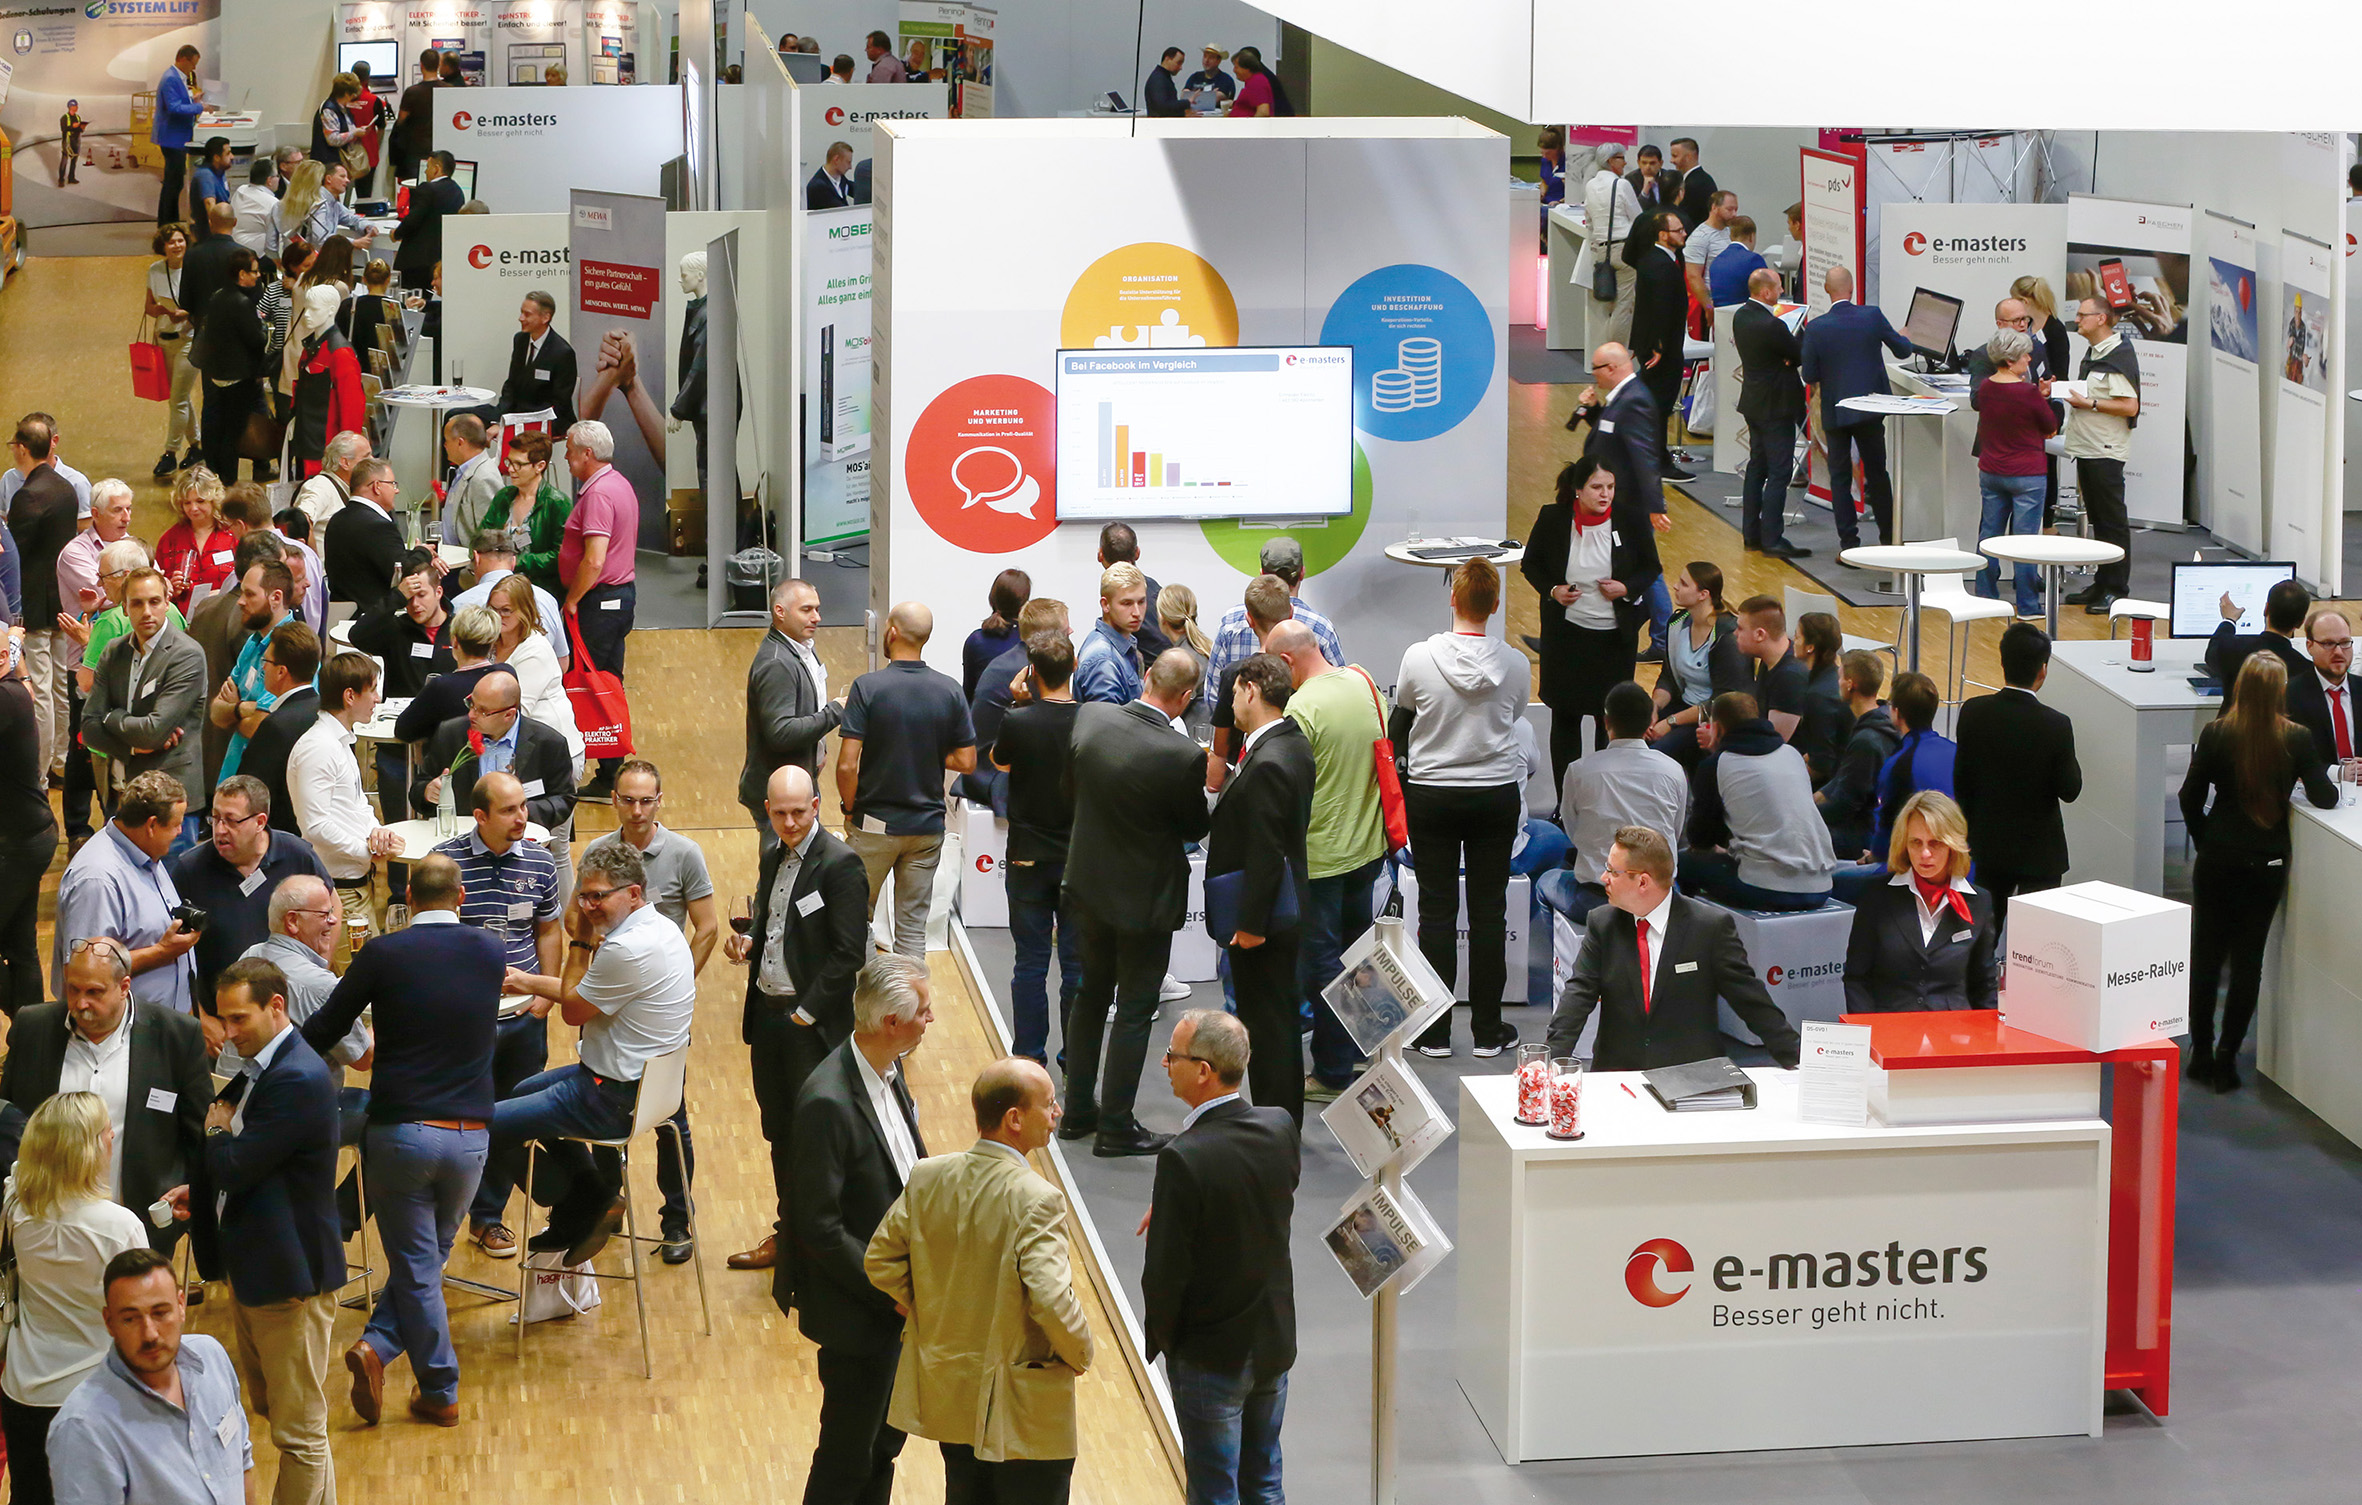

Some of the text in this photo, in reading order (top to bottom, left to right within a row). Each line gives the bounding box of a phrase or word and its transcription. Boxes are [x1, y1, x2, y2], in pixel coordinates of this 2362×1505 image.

[107, 1, 199, 14] SYSTEM LIFT
[497, 21, 525, 29] Einfach
[477, 113, 557, 127] e-masters
[849, 109, 929, 122] e-masters
[477, 129, 504, 137] Besser
[505, 129, 522, 138] geht
[849, 125, 873, 133] Besse
[1828, 178, 1841, 193] pds
[587, 210, 607, 221] MEWA
[1933, 235, 2027, 251] e-masters
[500, 246, 570, 264] e-mast
[1932, 254, 2012, 266] Besser geht nicht.
[500, 267, 532, 278] Besser
[535, 267, 557, 280] geht
[584, 265, 606, 276] Sichere
[606, 269, 643, 281] Partnerschaft
[584, 279, 633, 292] ein gutes Gefühl.
[826, 274, 872, 289] Alles im Gri
[817, 288, 872, 306] Alles ganz einf
[1383, 295, 1432, 303] INVESTITION
[584, 299, 612, 309] MENSCHEN.
[1389, 303, 1444, 311] BESCHAFFUNG
[1071, 359, 1197, 372] Bei Facebook im Vergleich
[1299, 354, 1346, 365] e-masters
[846, 460, 871, 474] MOS'ai
[584, 730, 611, 738] ELEKTRO
[584, 736, 618, 744] PRAKTIKER
[2011, 950, 2054, 971] trendforum
[1787, 961, 1846, 980] e-maste
[2107, 960, 2185, 989] Messe-Rallye
[1373, 948, 1420, 1009] IMPULSE
[2157, 1016, 2184, 1028] e-masters
[1372, 1192, 1419, 1254] IMPULSE
[1712, 1240, 1989, 1293] e-masters
[1713, 1297, 1946, 1330] Besser geht nicht.
